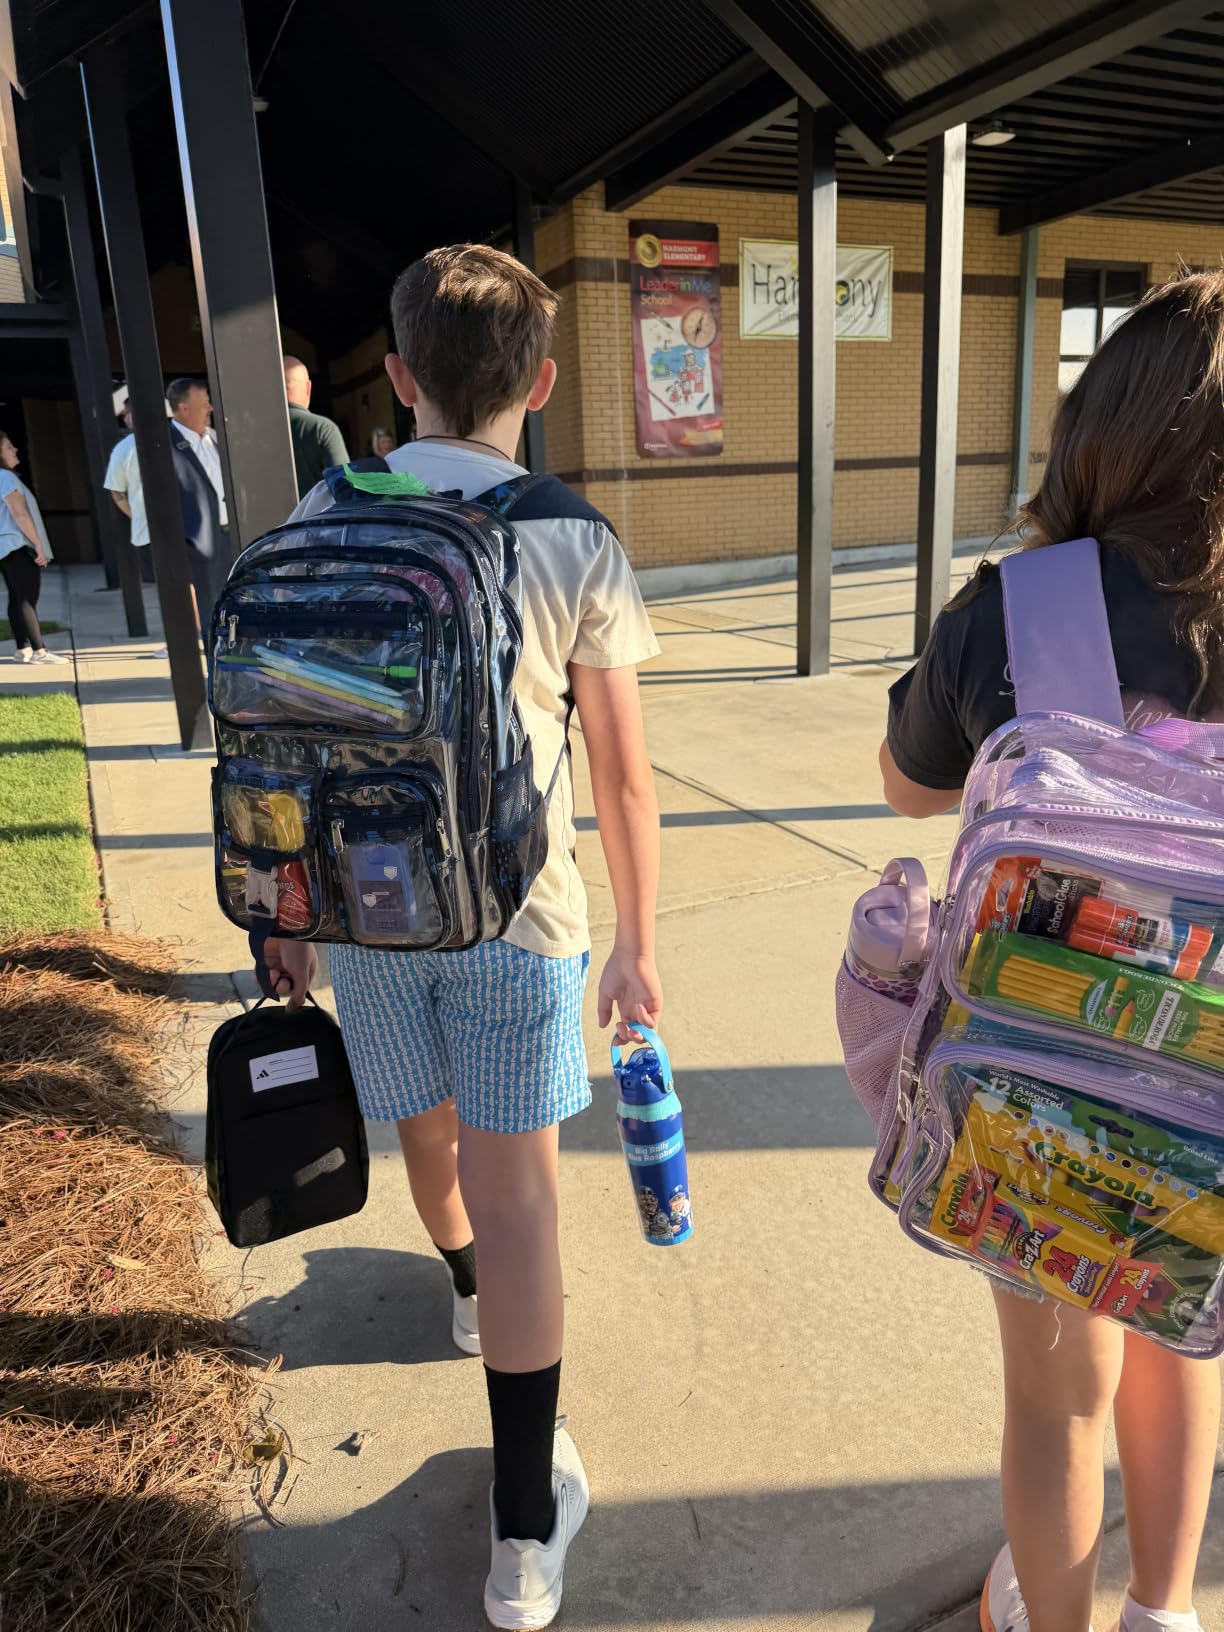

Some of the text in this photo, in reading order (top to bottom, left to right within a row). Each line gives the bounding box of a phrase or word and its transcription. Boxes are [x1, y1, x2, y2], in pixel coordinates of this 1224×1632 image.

[640, 294, 672, 305] School
[1148, 997, 1174, 1045] TICONDEROGA
[989, 1070, 1060, 1100] World's Most Washable
[989, 1077, 1011, 1096] 12
[1015, 1086, 1064, 1110] Assorted
[1013, 1093, 1046, 1112] Colors
[1035, 1141, 1156, 1208] Crayola
[1043, 1245, 1078, 1283] 24
[1067, 1255, 1091, 1292] Crayons
[1120, 1268, 1142, 1287] 24
